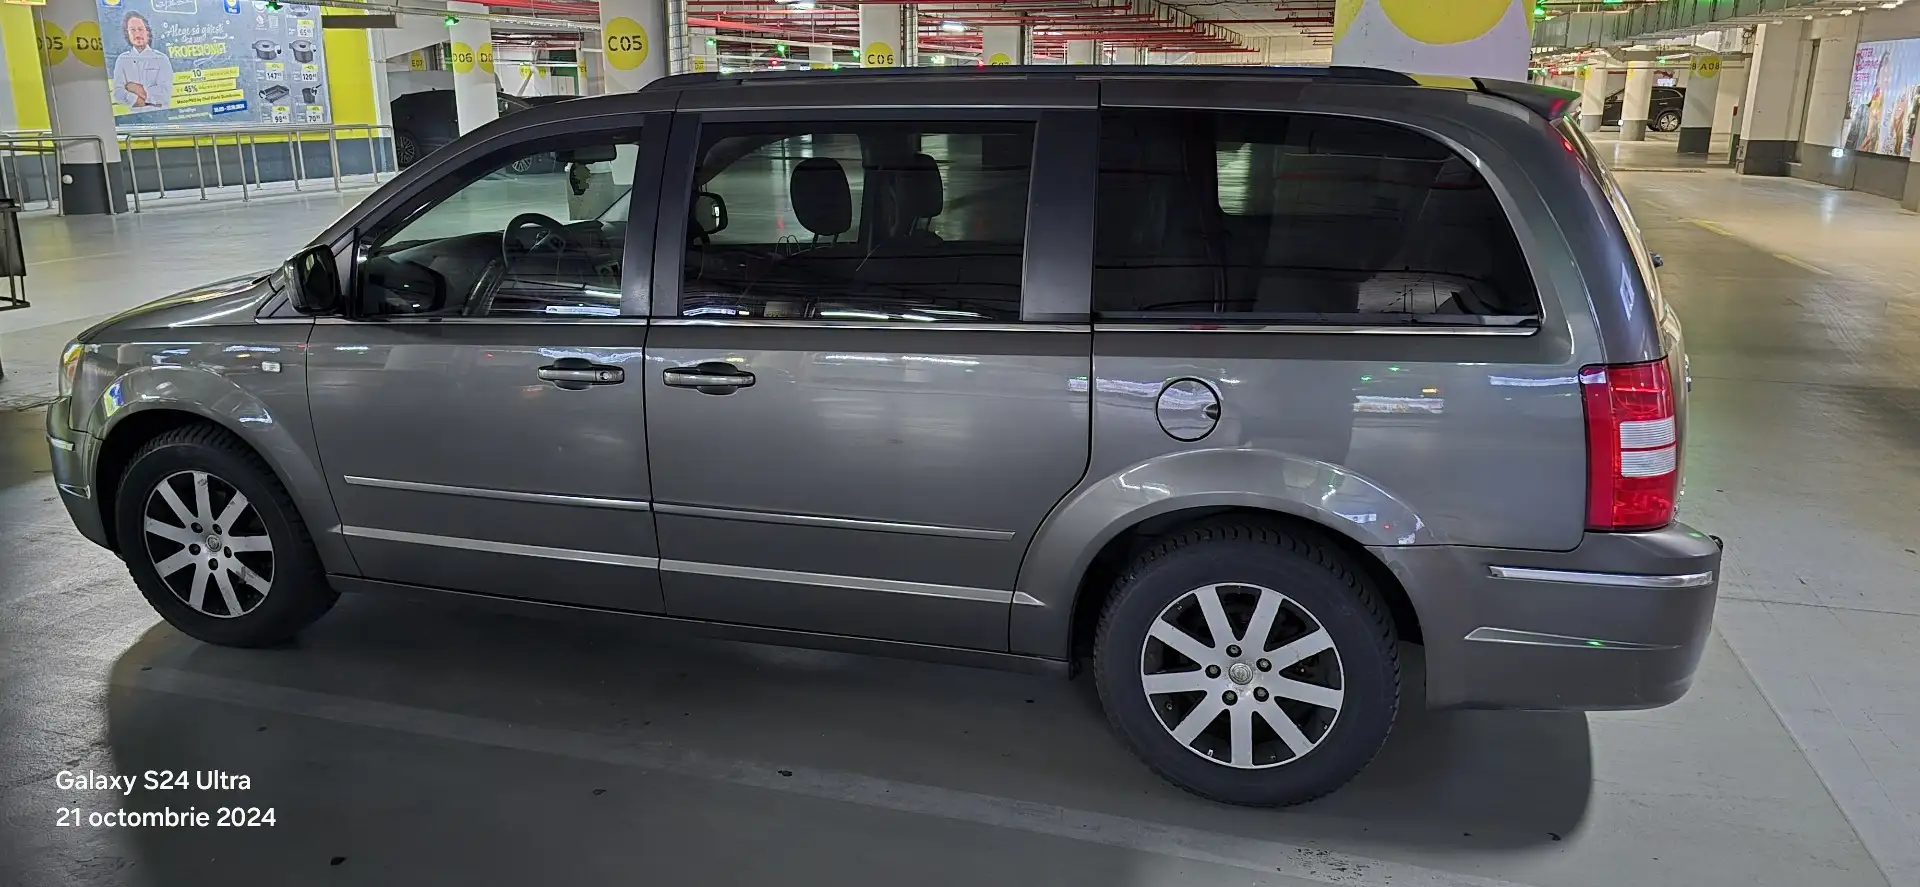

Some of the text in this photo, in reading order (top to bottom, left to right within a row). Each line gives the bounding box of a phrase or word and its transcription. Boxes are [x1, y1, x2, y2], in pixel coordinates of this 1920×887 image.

[608, 35, 642, 51] C05
[867, 54, 894, 64] C06
[1699, 62, 1720, 71] A08
